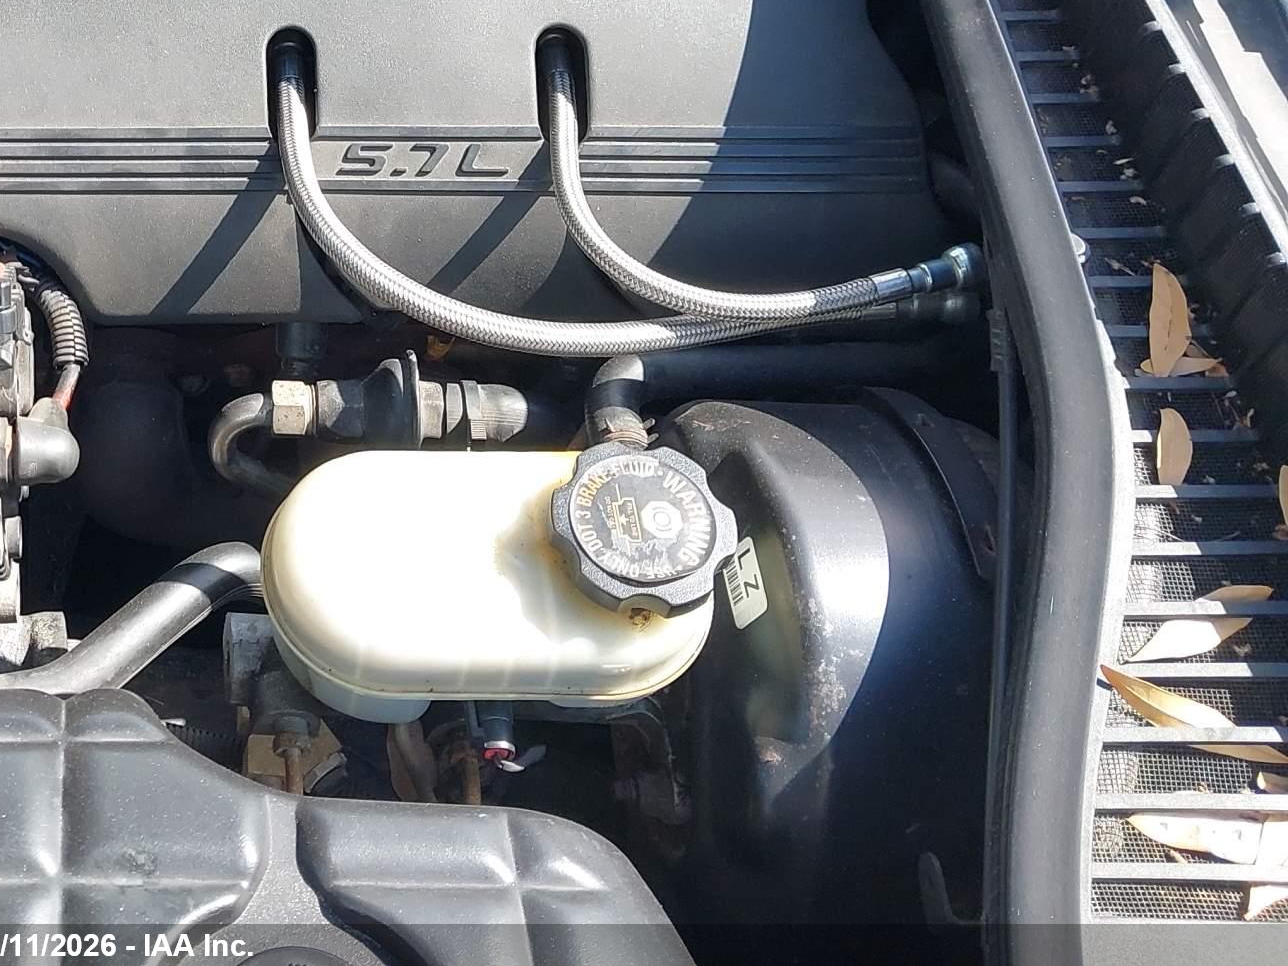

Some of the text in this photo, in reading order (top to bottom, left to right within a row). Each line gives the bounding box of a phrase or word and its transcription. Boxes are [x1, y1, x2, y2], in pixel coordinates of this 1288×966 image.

[334, 143, 510, 178] 5.7L
[575, 509, 592, 520] 3
[662, 469, 712, 566] WARNING
[578, 522, 604, 550] DOT
